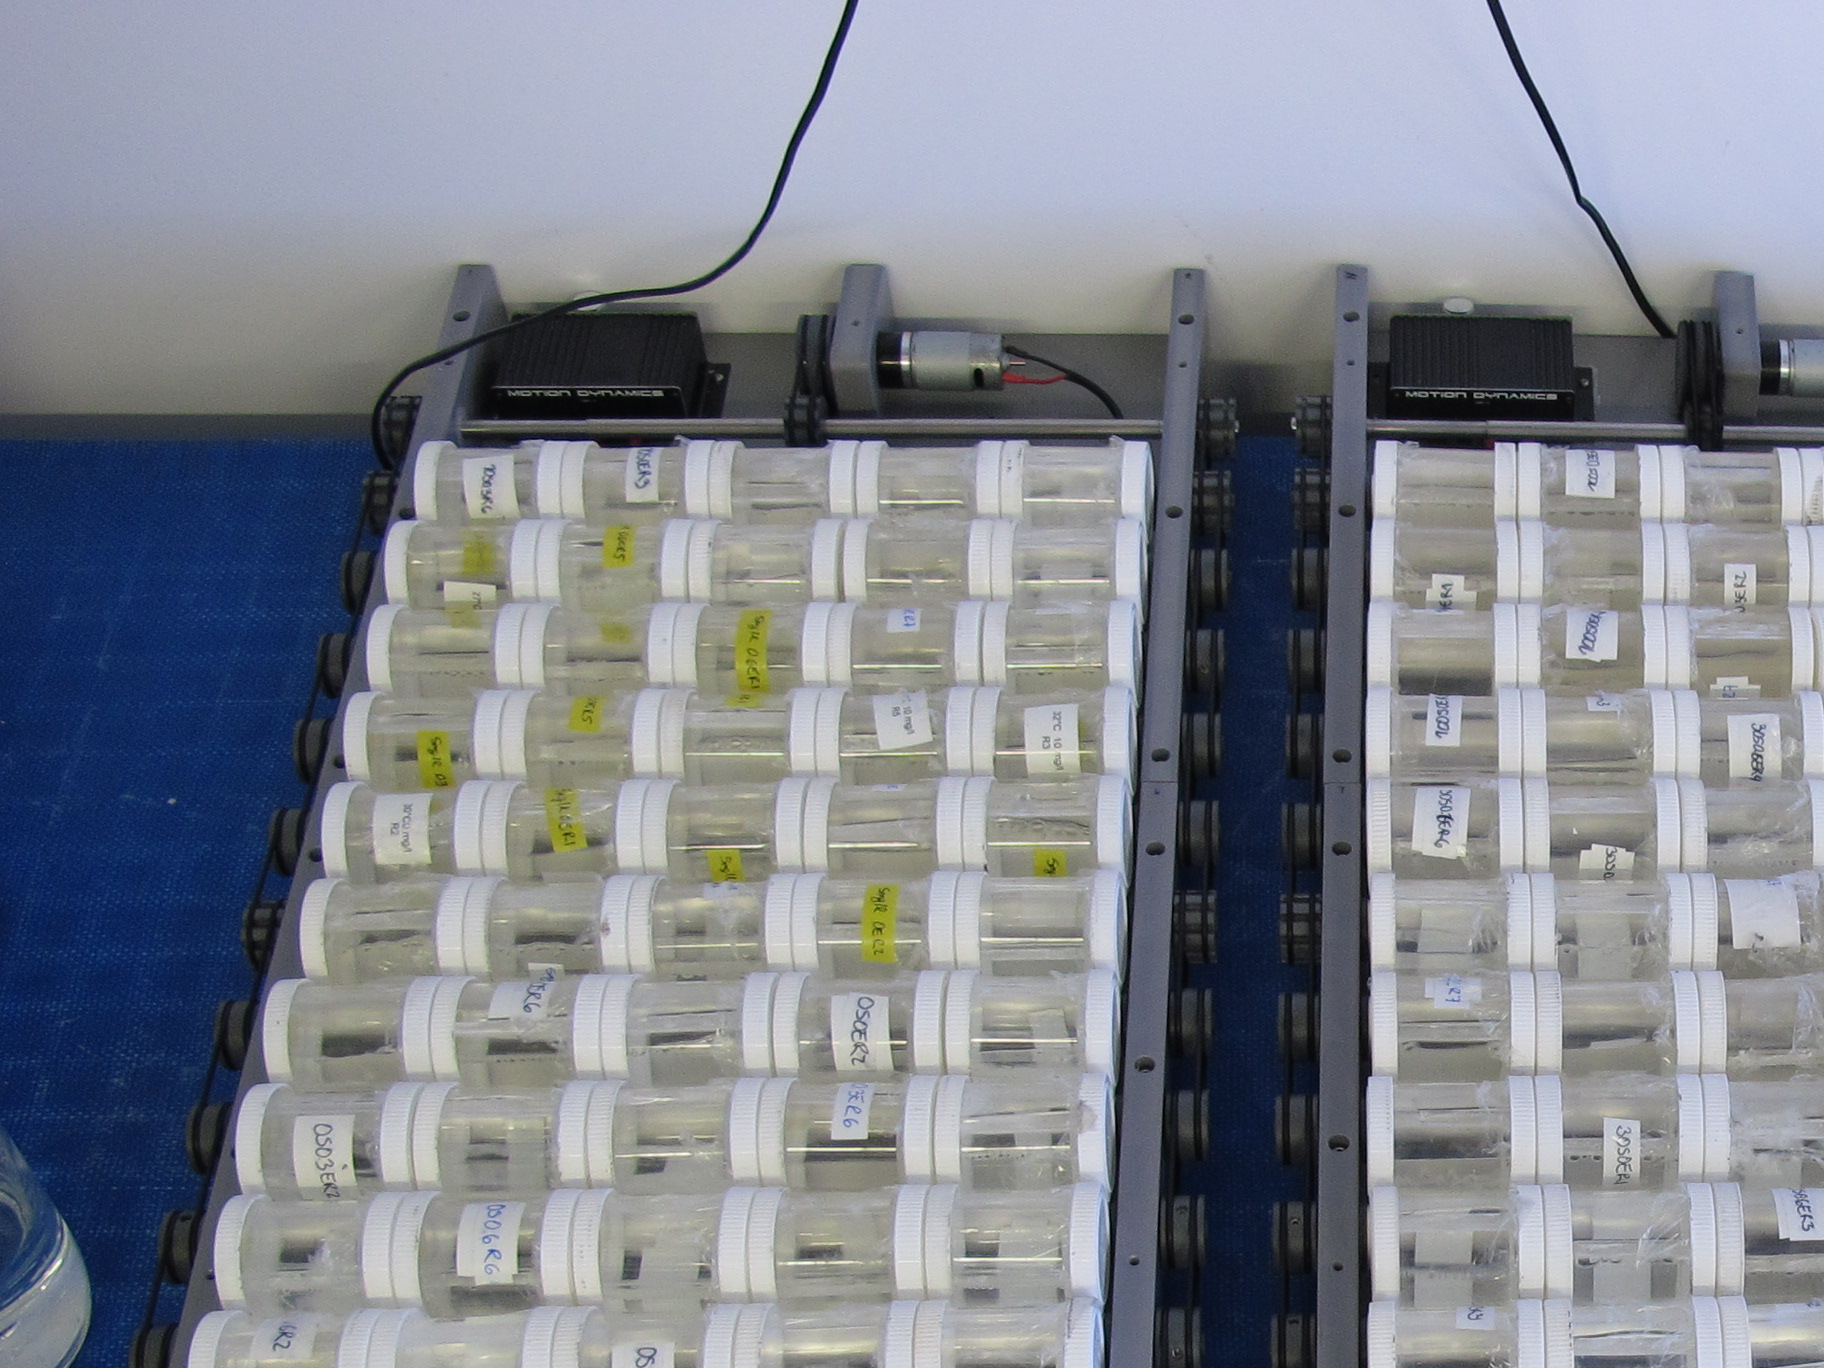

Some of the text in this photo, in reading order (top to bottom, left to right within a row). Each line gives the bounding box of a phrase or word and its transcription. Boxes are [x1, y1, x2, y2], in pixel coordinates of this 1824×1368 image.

[507, 389, 665, 398] MOTION DYNAMICS
[1405, 390, 1558, 401] MOTION DYNAMICS
